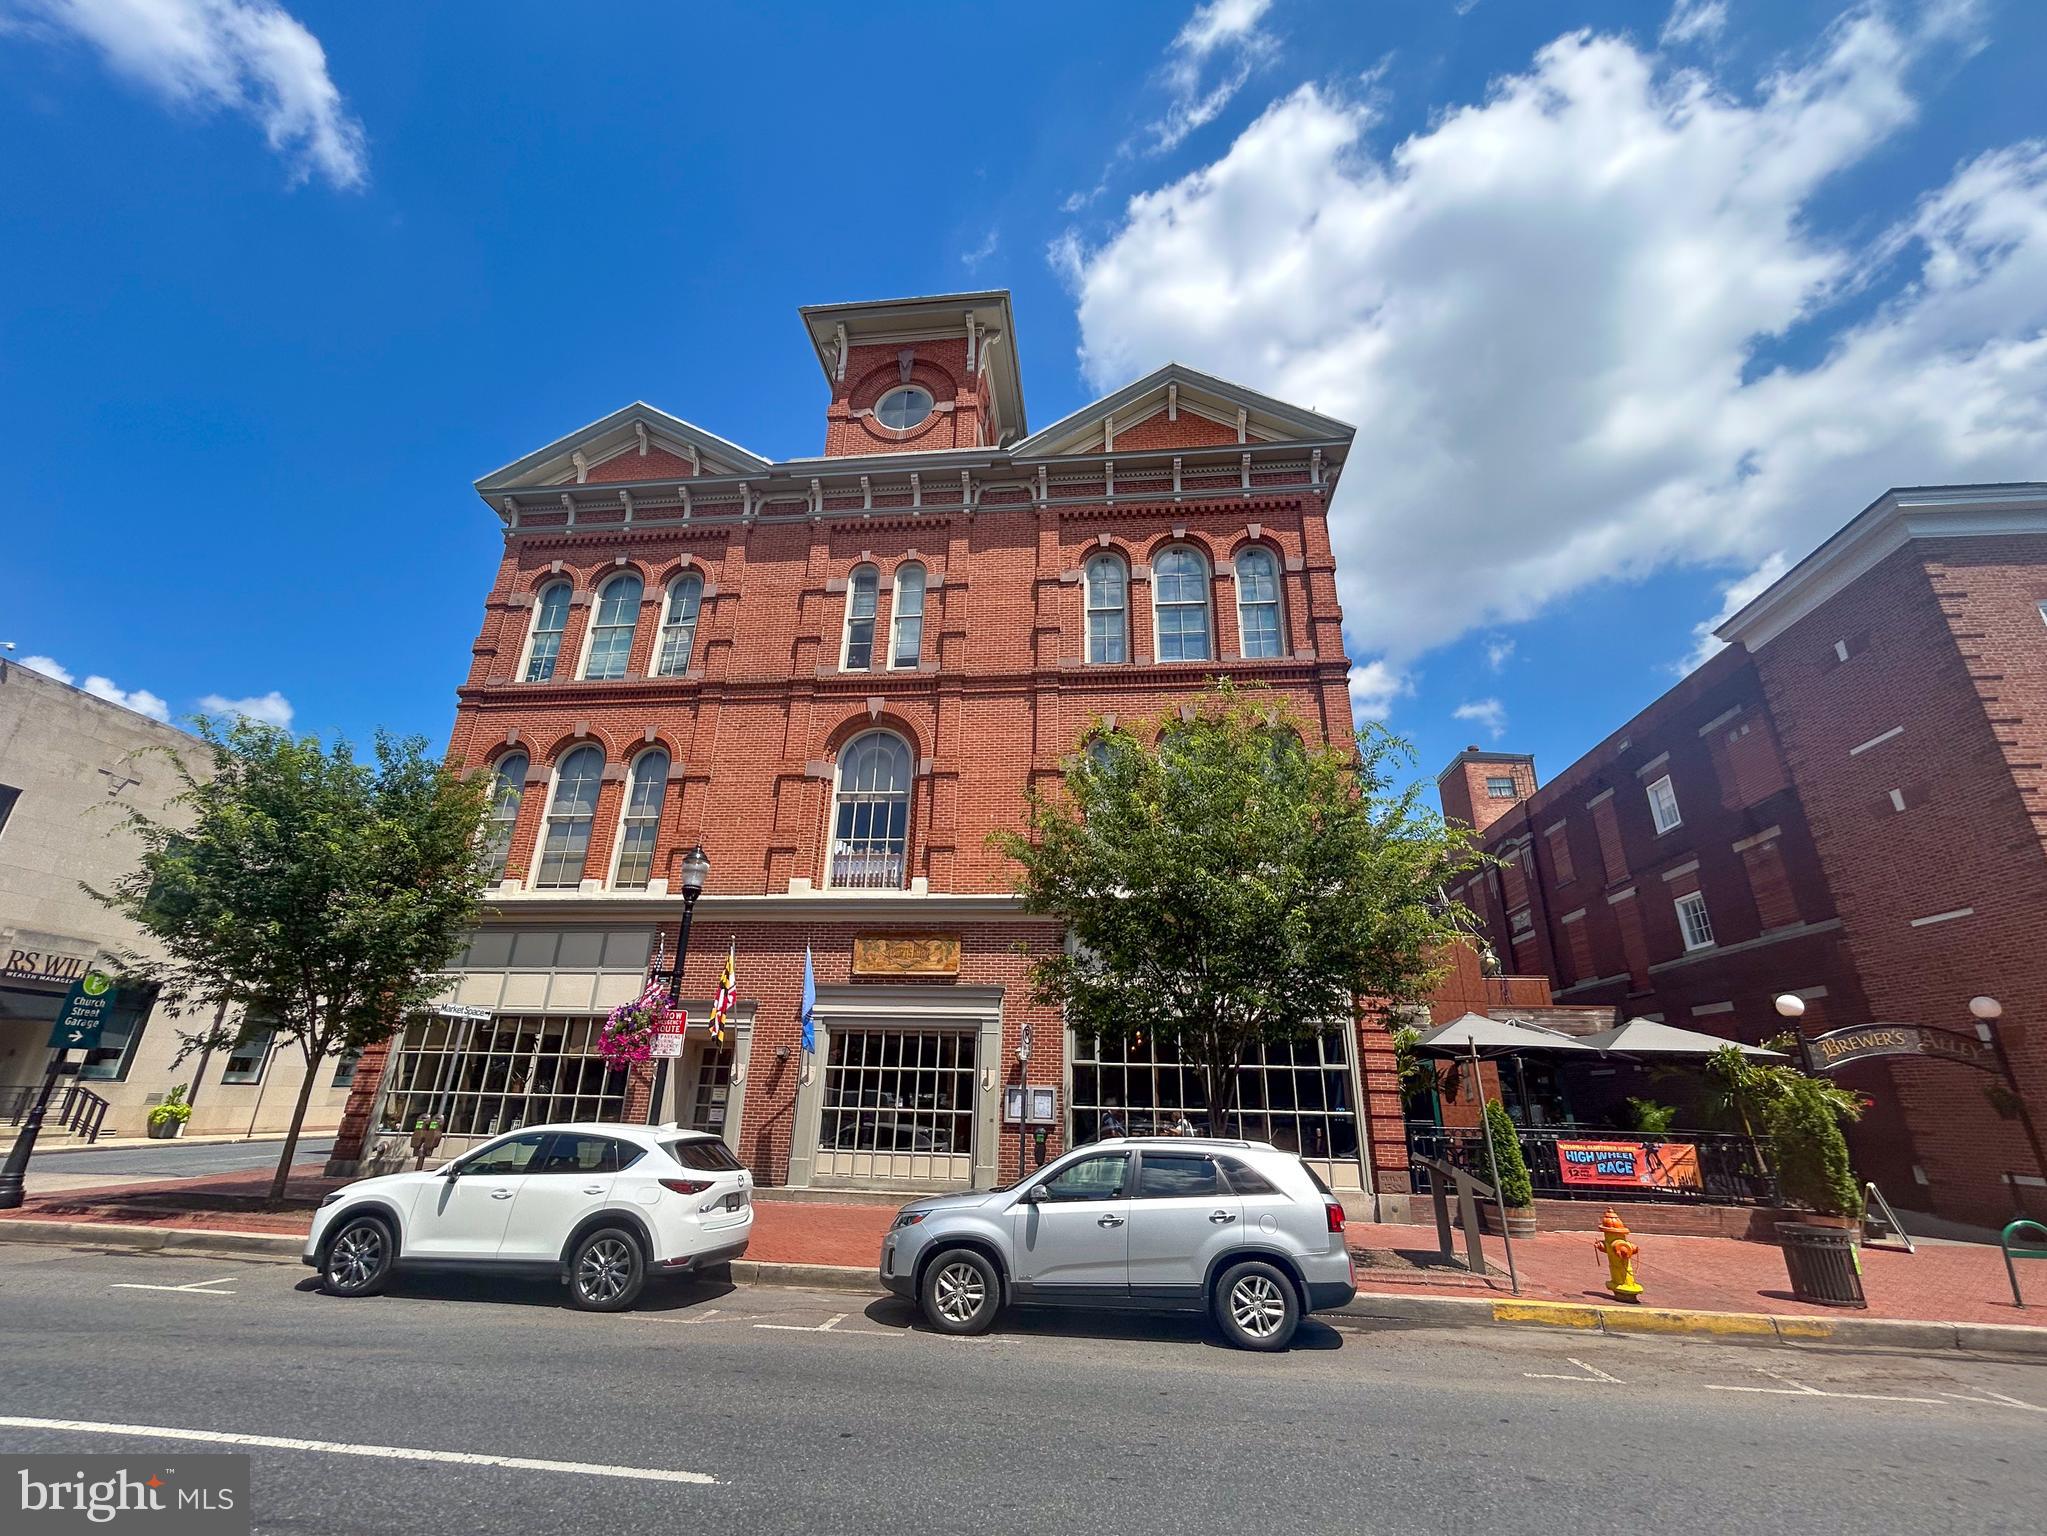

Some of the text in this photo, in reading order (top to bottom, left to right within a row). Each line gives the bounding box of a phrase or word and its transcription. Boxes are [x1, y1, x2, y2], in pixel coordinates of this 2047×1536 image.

[6, 971, 37, 980] WEALTH
[74, 997, 105, 1008] Church
[71, 1007, 100, 1017] Street
[441, 1003, 485, 1017] Market Space
[64, 1017, 99, 1029] Garage
[1566, 1150, 1636, 1162] HIGH WHEEL
[1568, 1168, 1580, 1177] 12
[1597, 1161, 1634, 1174] RACE
